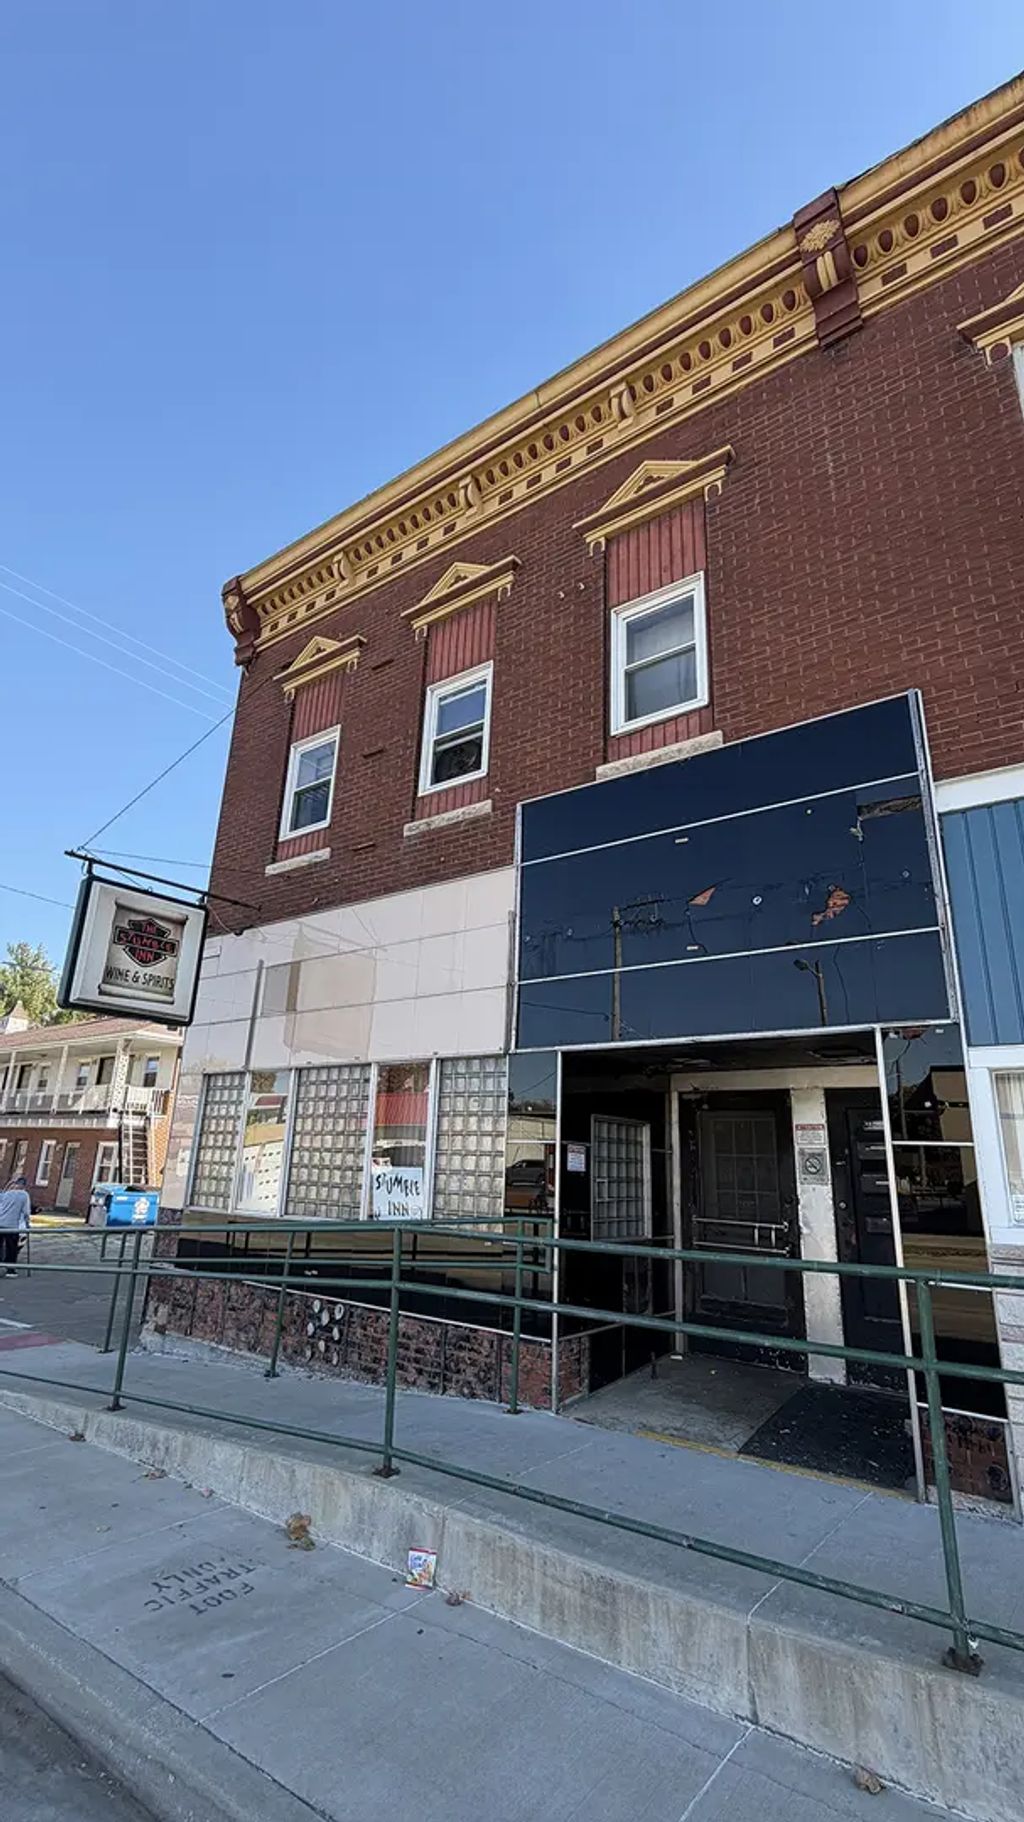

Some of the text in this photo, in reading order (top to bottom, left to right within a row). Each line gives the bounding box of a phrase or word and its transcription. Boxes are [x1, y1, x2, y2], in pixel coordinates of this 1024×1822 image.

[135, 949, 154, 961] INN
[106, 966, 176, 990] WINE & SPIRITS
[388, 1200, 409, 1216] INN
[144, 1564, 256, 1612] TRAFFIC
[152, 1561, 216, 1593] ONLY
[189, 1582, 255, 1615] FOOT
